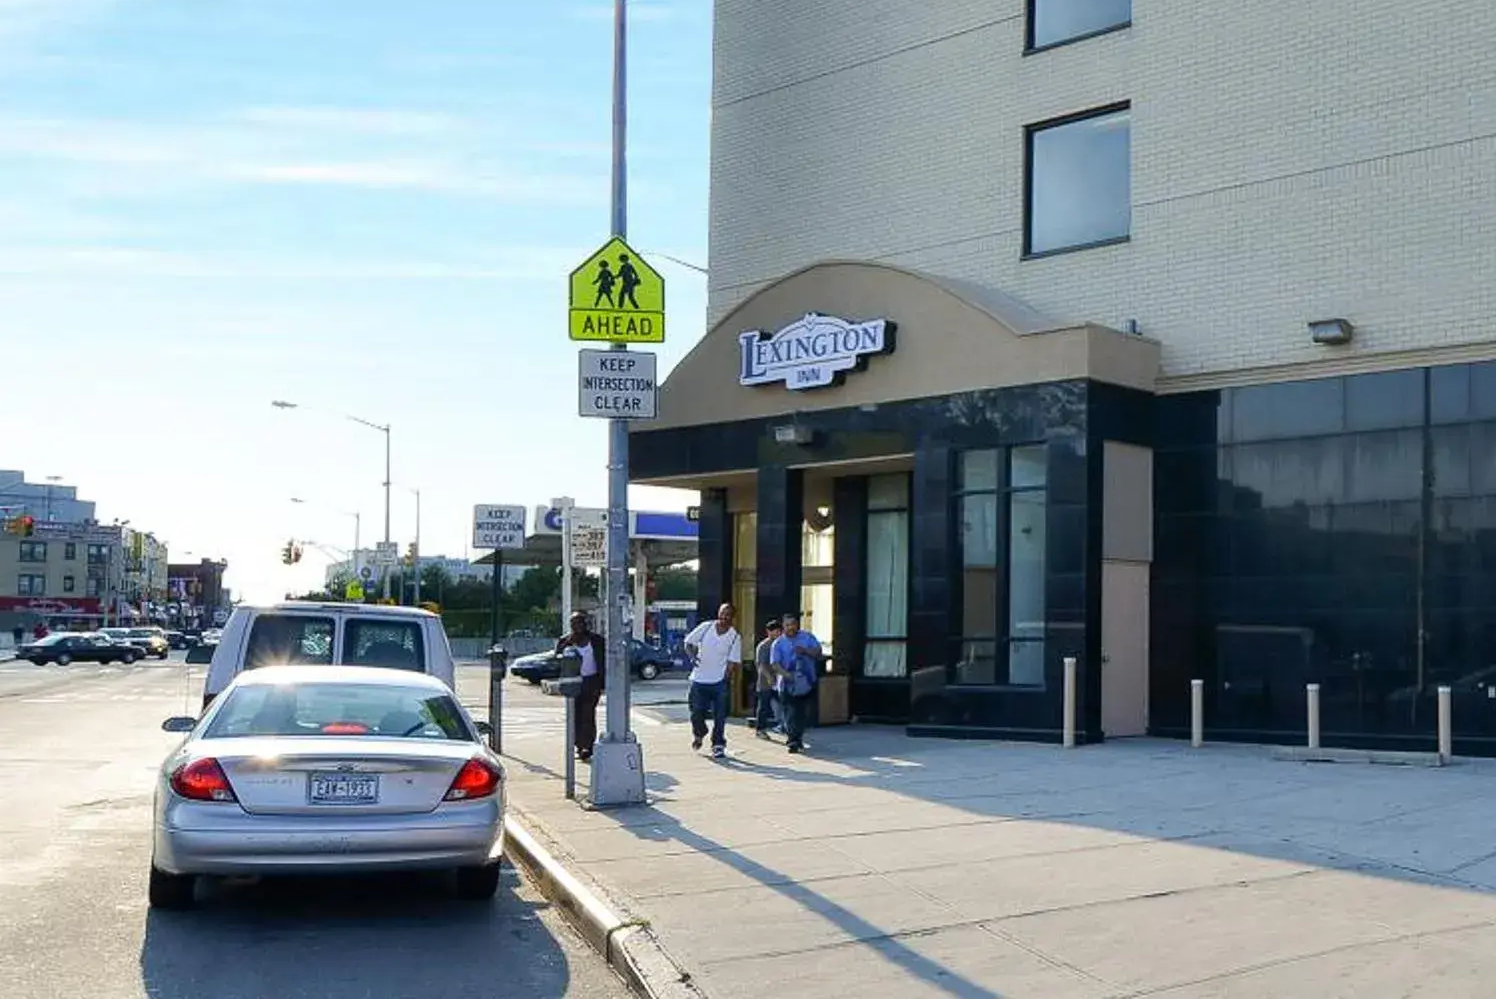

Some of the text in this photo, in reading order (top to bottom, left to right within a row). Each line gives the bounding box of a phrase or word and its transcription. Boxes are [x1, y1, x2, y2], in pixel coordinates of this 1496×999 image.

[582, 315, 653, 336] AHEAD
[599, 358, 636, 372] KEEP
[797, 368, 821, 383] INN
[583, 377, 653, 391] INTERSECTION
[594, 396, 641, 411] CLEAR
[488, 510, 511, 519] KEEP
